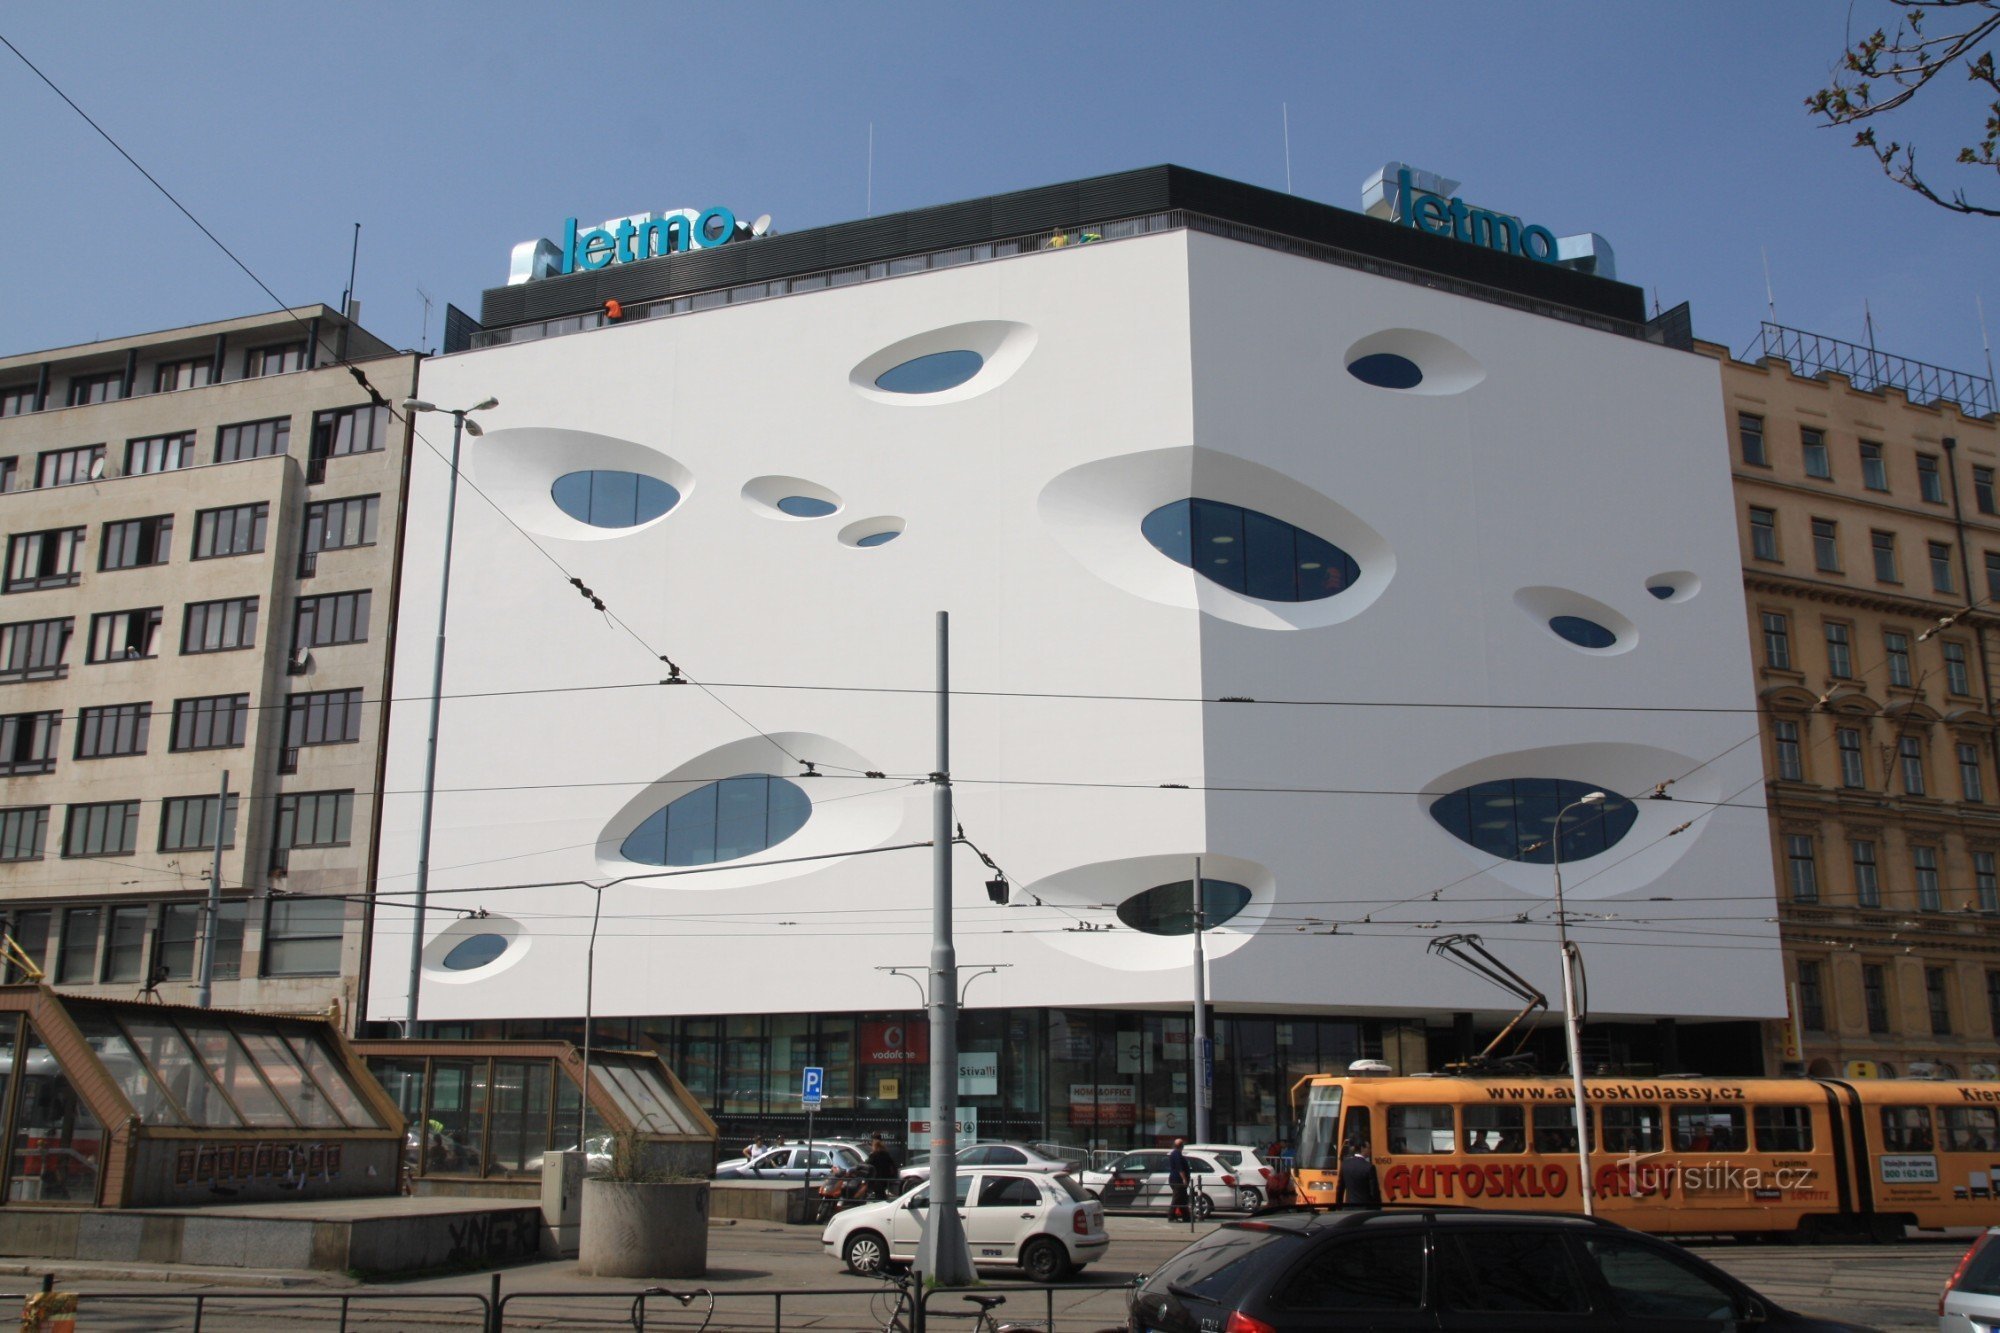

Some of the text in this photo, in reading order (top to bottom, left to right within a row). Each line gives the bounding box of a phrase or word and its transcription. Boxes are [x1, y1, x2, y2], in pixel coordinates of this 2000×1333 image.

[1397, 167, 1559, 263] letmo
[562, 206, 735, 275] letmo
[959, 1066, 996, 1077] Stivalli
[1073, 1087, 1132, 1096] HOM&OFFICE
[1384, 1163, 1568, 1202] AUTOSKLO
